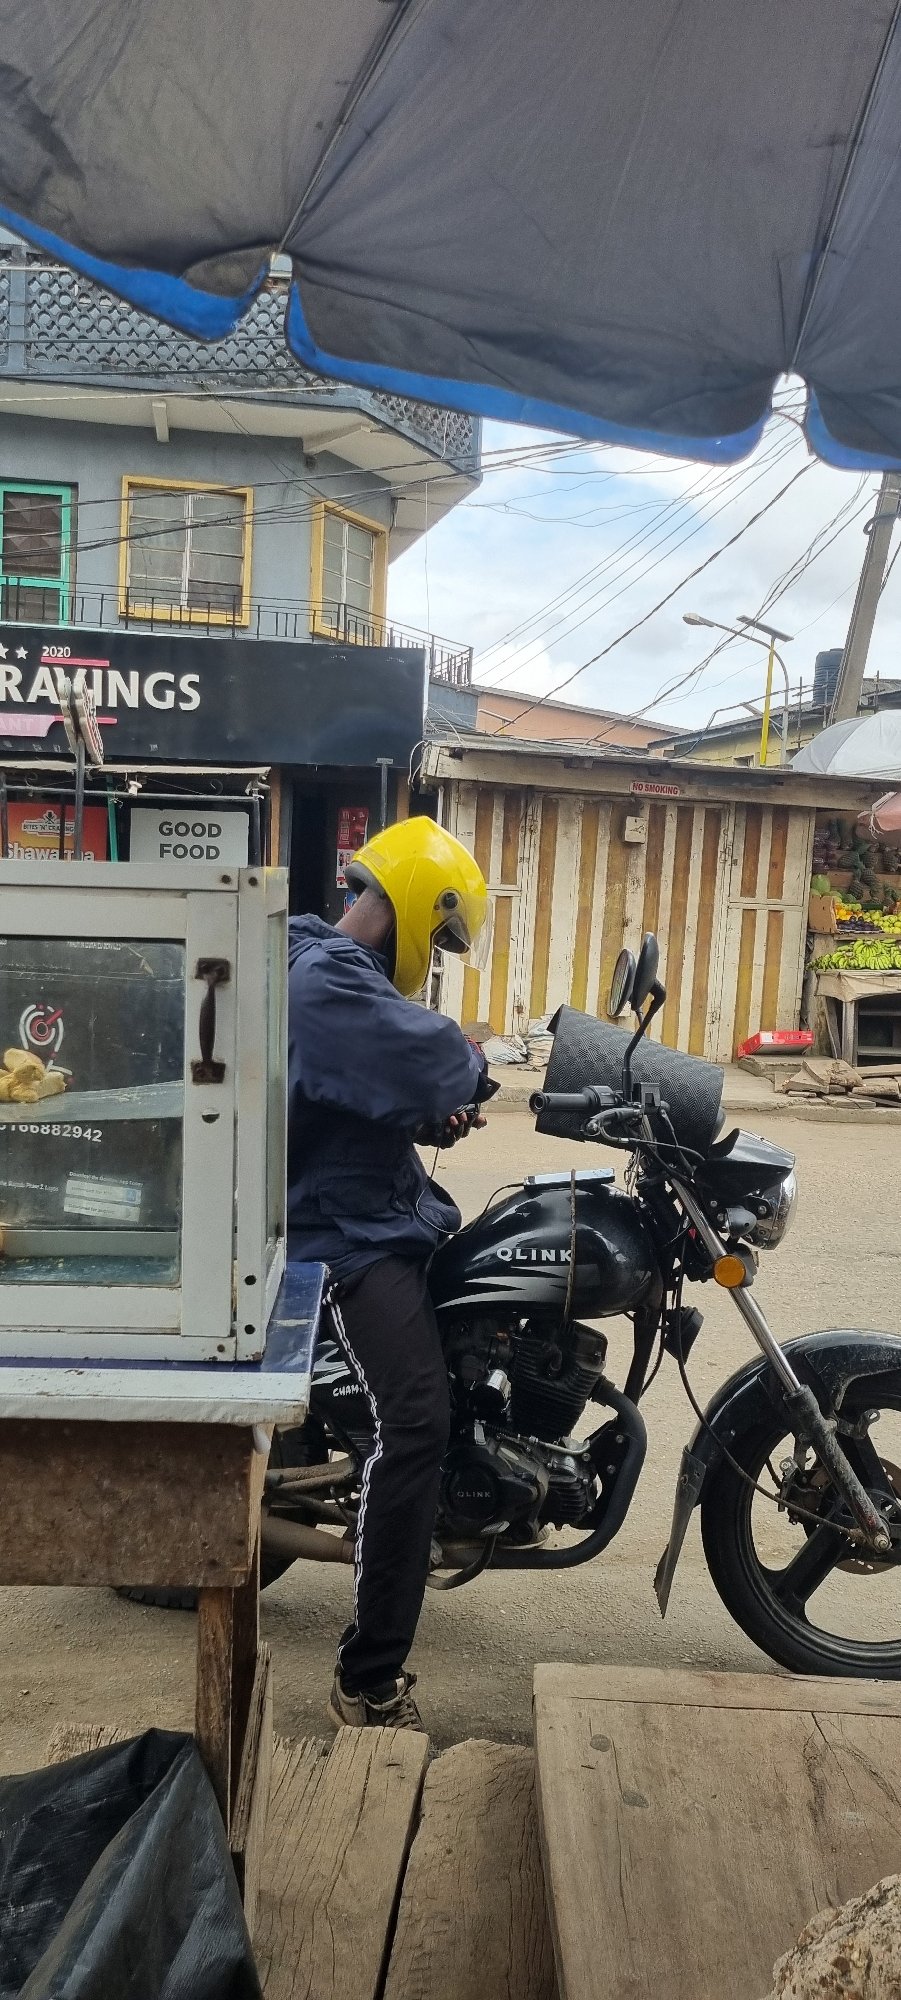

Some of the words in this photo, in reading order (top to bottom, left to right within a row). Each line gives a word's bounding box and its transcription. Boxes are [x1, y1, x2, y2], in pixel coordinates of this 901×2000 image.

[42, 646, 71, 658] 2020
[632, 782, 644, 791] NO
[644, 783, 679, 795] SMOKING
[158, 821, 222, 838] GOOD
[8, 842, 95, 861] Shawara
[159, 843, 220, 860] FOOD
[496, 1247, 573, 1262] QLINK
[332, 1384, 363, 1397] CHAM
